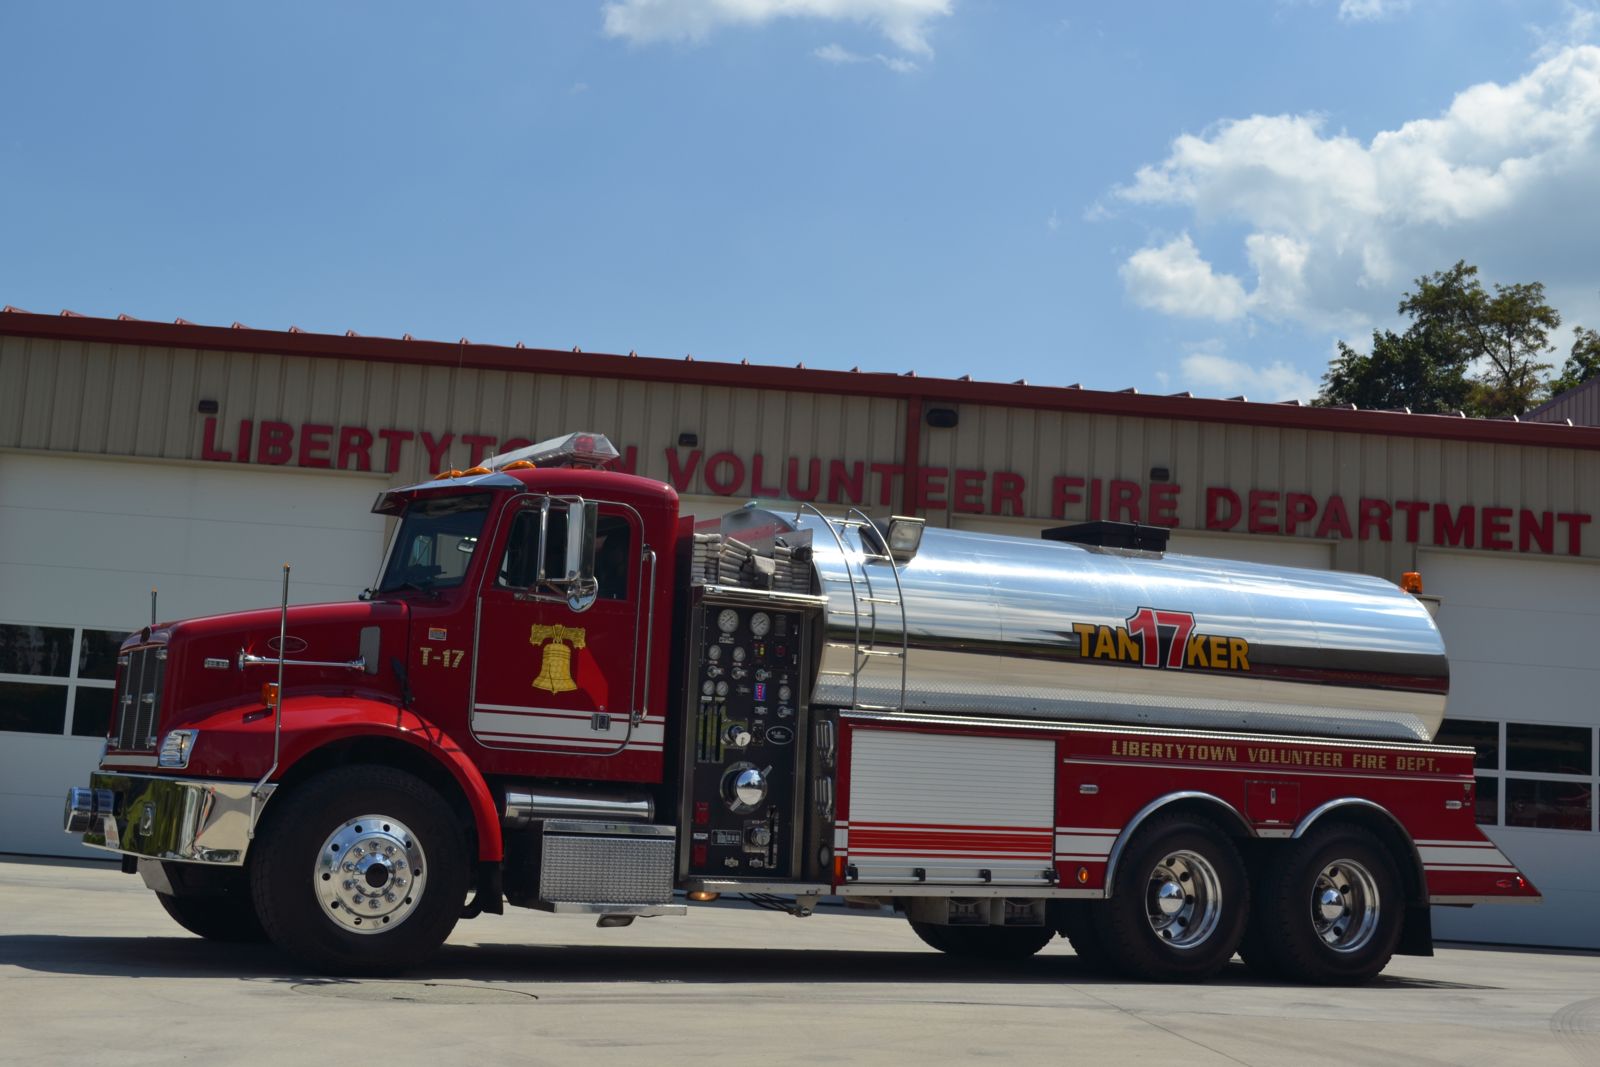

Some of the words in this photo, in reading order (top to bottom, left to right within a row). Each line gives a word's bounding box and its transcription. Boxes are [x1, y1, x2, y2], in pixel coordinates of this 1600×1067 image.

[202, 417, 638, 476] LIBERTYTN
[664, 447, 1027, 517] VOLUNTEER
[1052, 475, 1182, 528] FIRE
[1205, 486, 1592, 556] DEPARTMENT
[419, 646, 465, 668] T-17
[1112, 739, 1238, 762] LIBERTYTOWN
[1248, 748, 1343, 768] VOLUNTEER
[1352, 753, 1387, 769] FIRE
